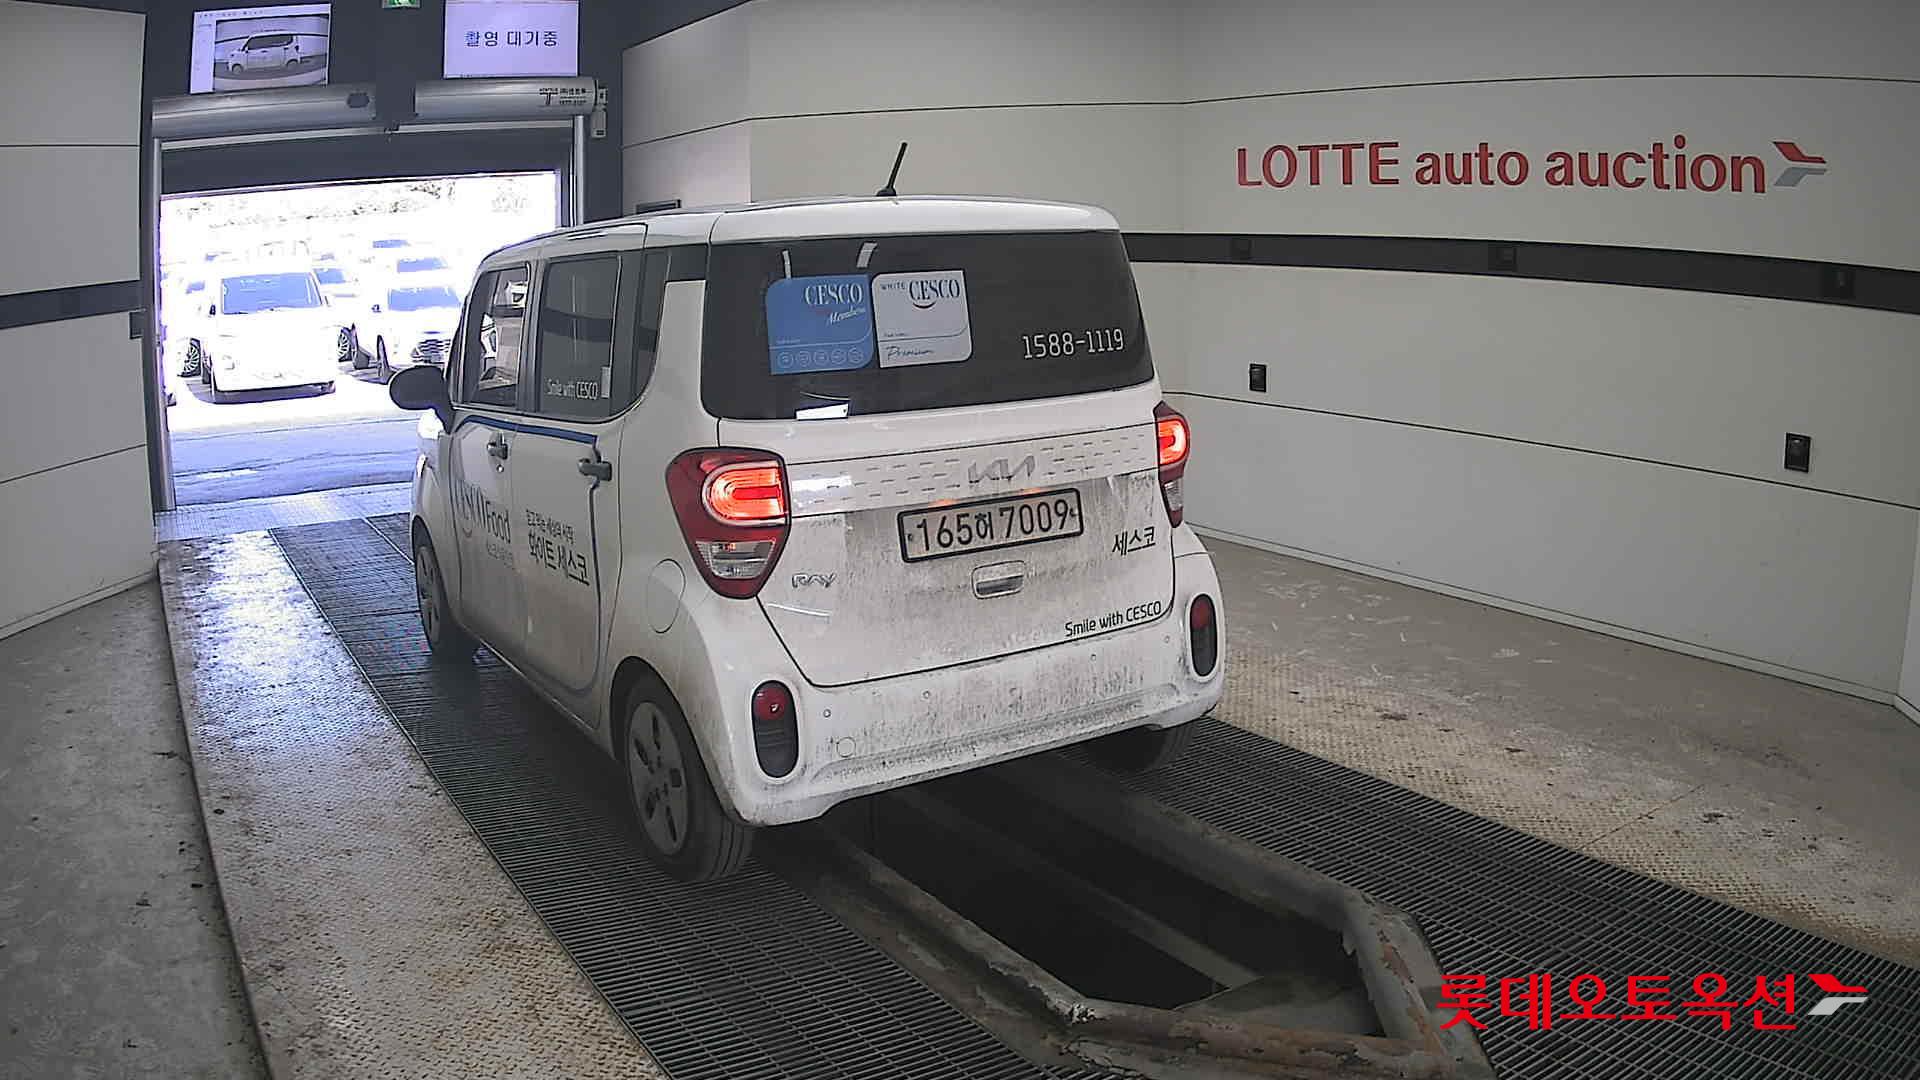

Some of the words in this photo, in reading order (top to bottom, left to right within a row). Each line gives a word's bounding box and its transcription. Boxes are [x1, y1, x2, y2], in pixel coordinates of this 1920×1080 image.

[506, 30, 558, 47] 대기중
[1237, 141, 1400, 188] LOTTE
[1415, 142, 1529, 187] auto
[1544, 134, 1766, 194] auction
[804, 282, 863, 306] CESCO
[908, 278, 960, 301] CESCO
[1022, 328, 1124, 359] 1588-1119
[1111, 525, 1156, 557] 세스코
[1064, 618, 1097, 637] Smile
[1098, 610, 1123, 629] with
[1125, 600, 1162, 622] CESCO
